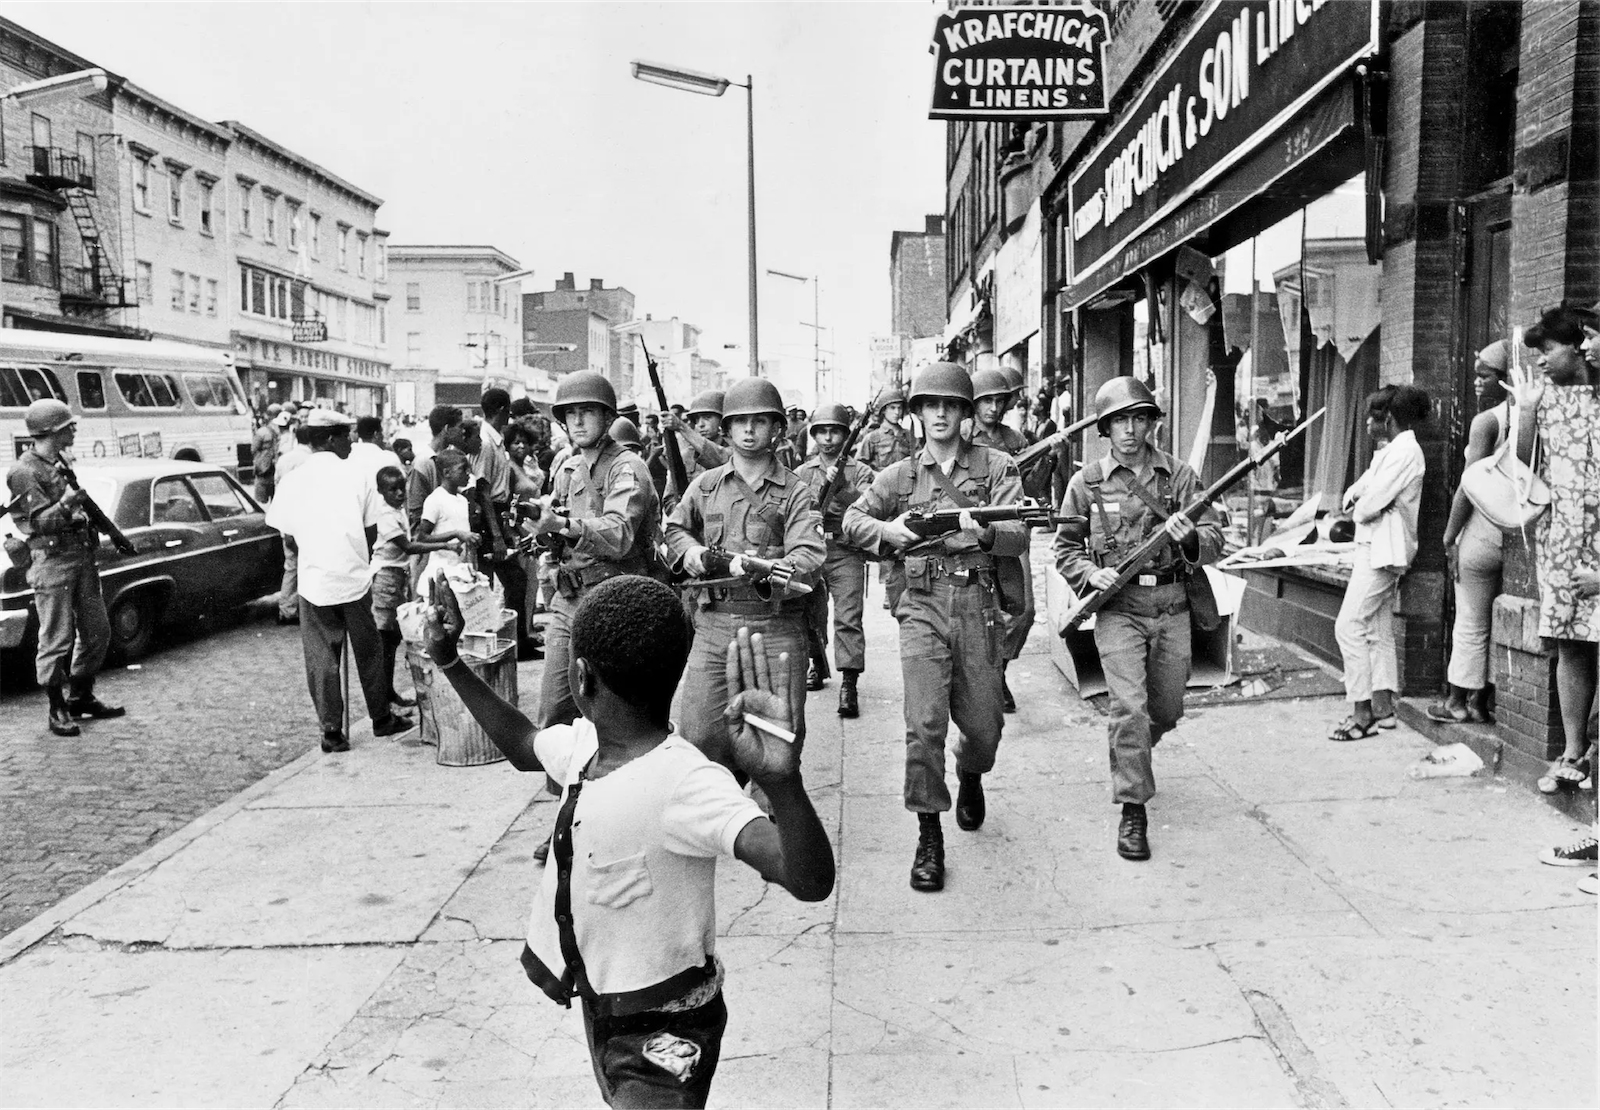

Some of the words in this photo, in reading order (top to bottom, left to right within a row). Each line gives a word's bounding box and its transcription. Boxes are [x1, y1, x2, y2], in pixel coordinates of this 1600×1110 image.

[943, 12, 1099, 53] KRAFCHICK
[943, 58, 1096, 86] CURTAINS
[969, 88, 1069, 107] LINENS
[1105, 83, 1183, 227] KRAFCHICK
[1186, 96, 1198, 150] &
[1199, 7, 1250, 136] SON
